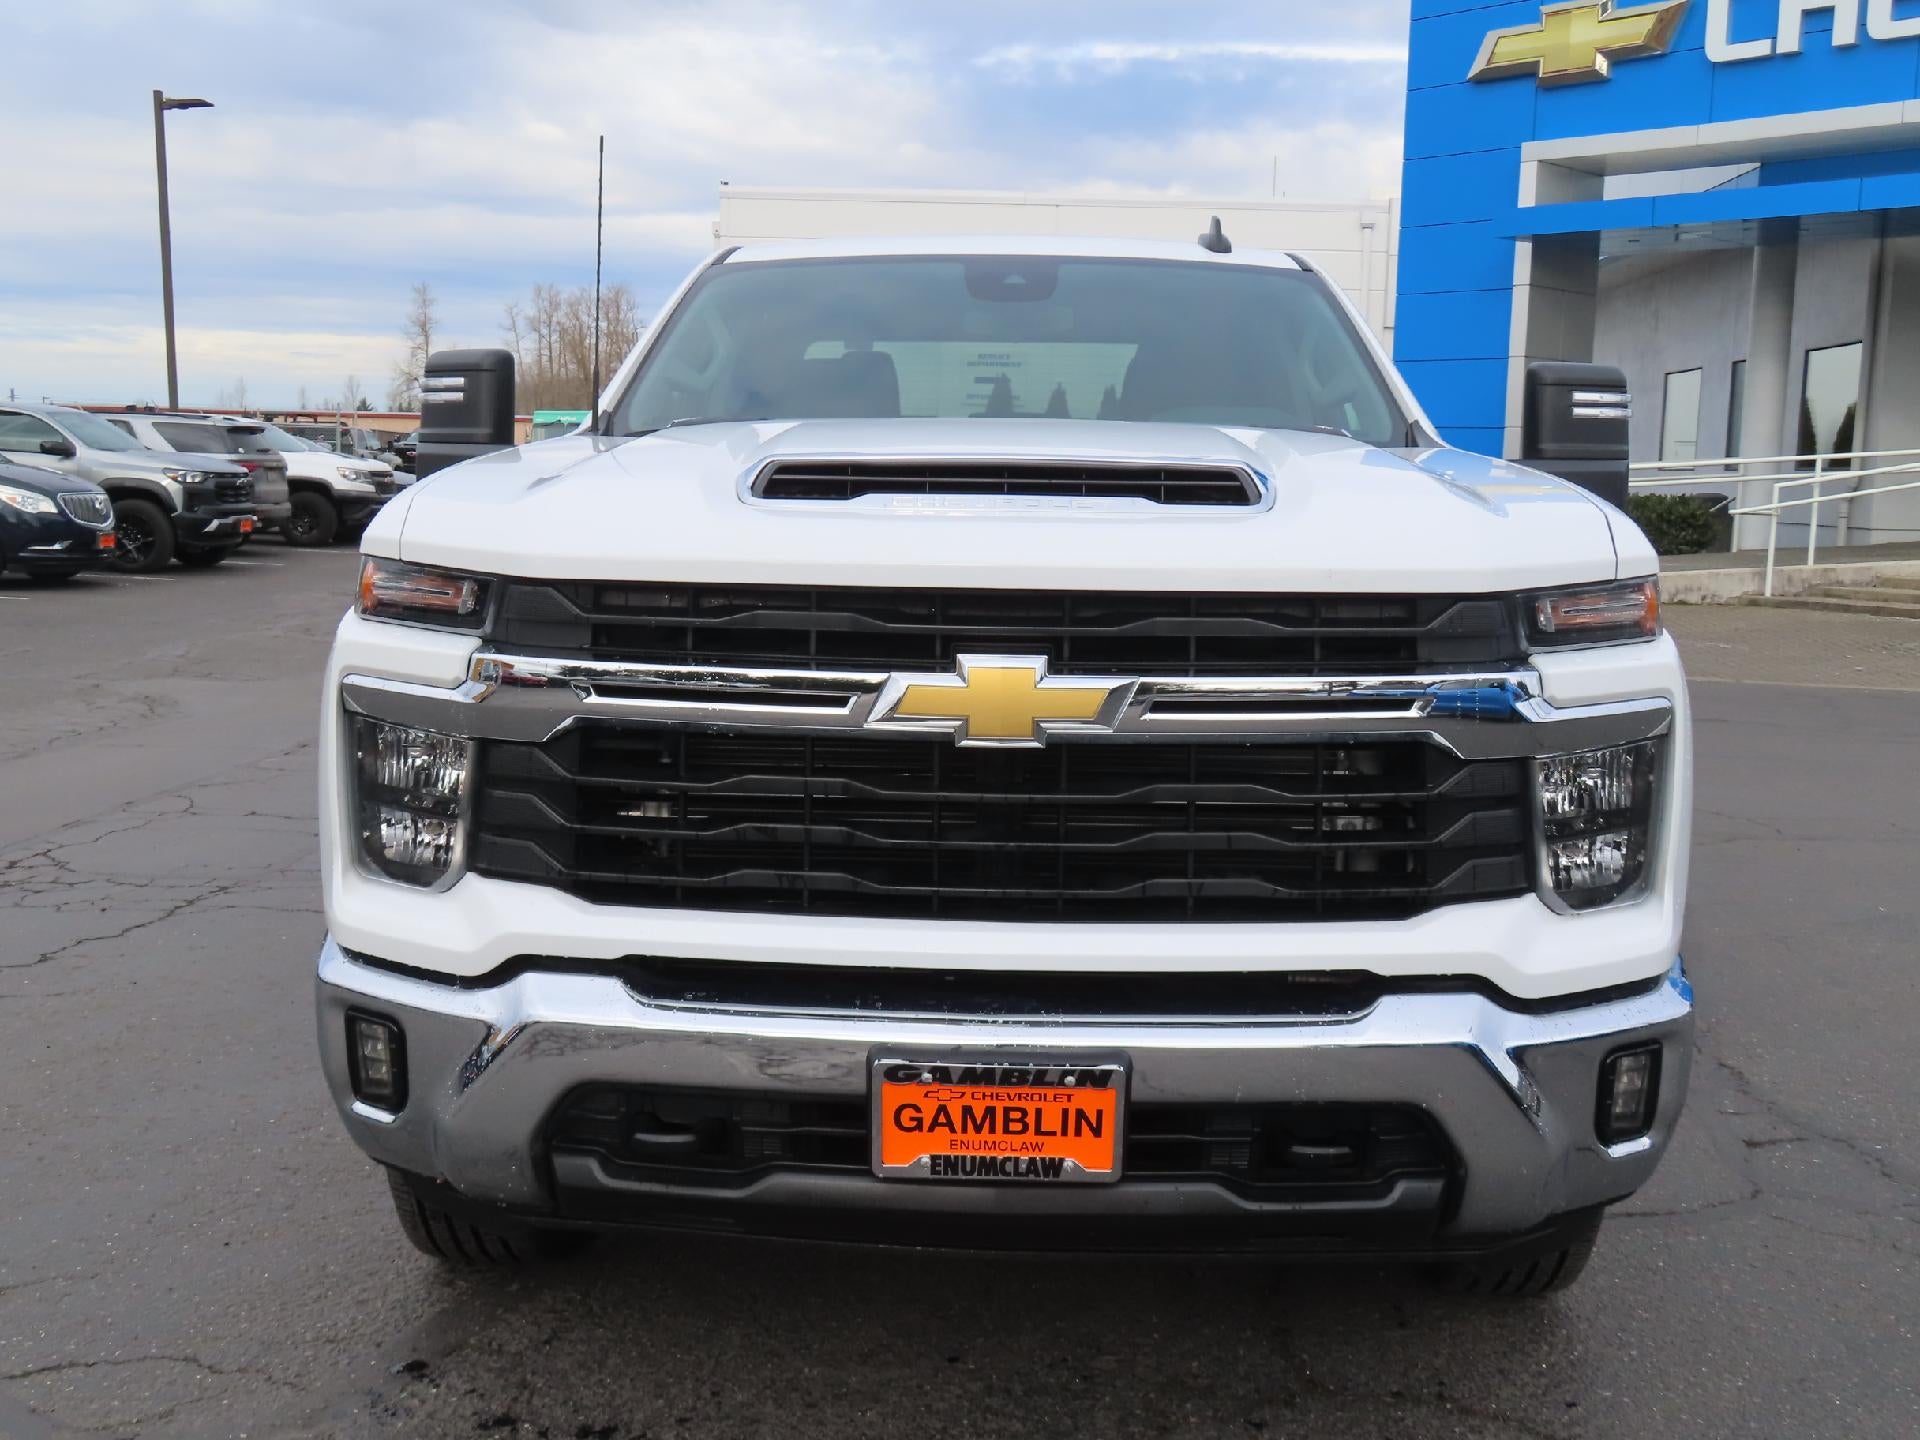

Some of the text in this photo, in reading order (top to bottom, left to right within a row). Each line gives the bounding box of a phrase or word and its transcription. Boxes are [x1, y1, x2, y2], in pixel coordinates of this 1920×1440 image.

[883, 1064, 1113, 1088] GAMBLIN
[970, 1091, 1075, 1103] CHEVROLET
[893, 1103, 1104, 1138] GAMBLIN
[949, 1139, 1045, 1153] ENUMCLAW
[930, 1155, 1066, 1179] ENUMCLAW
